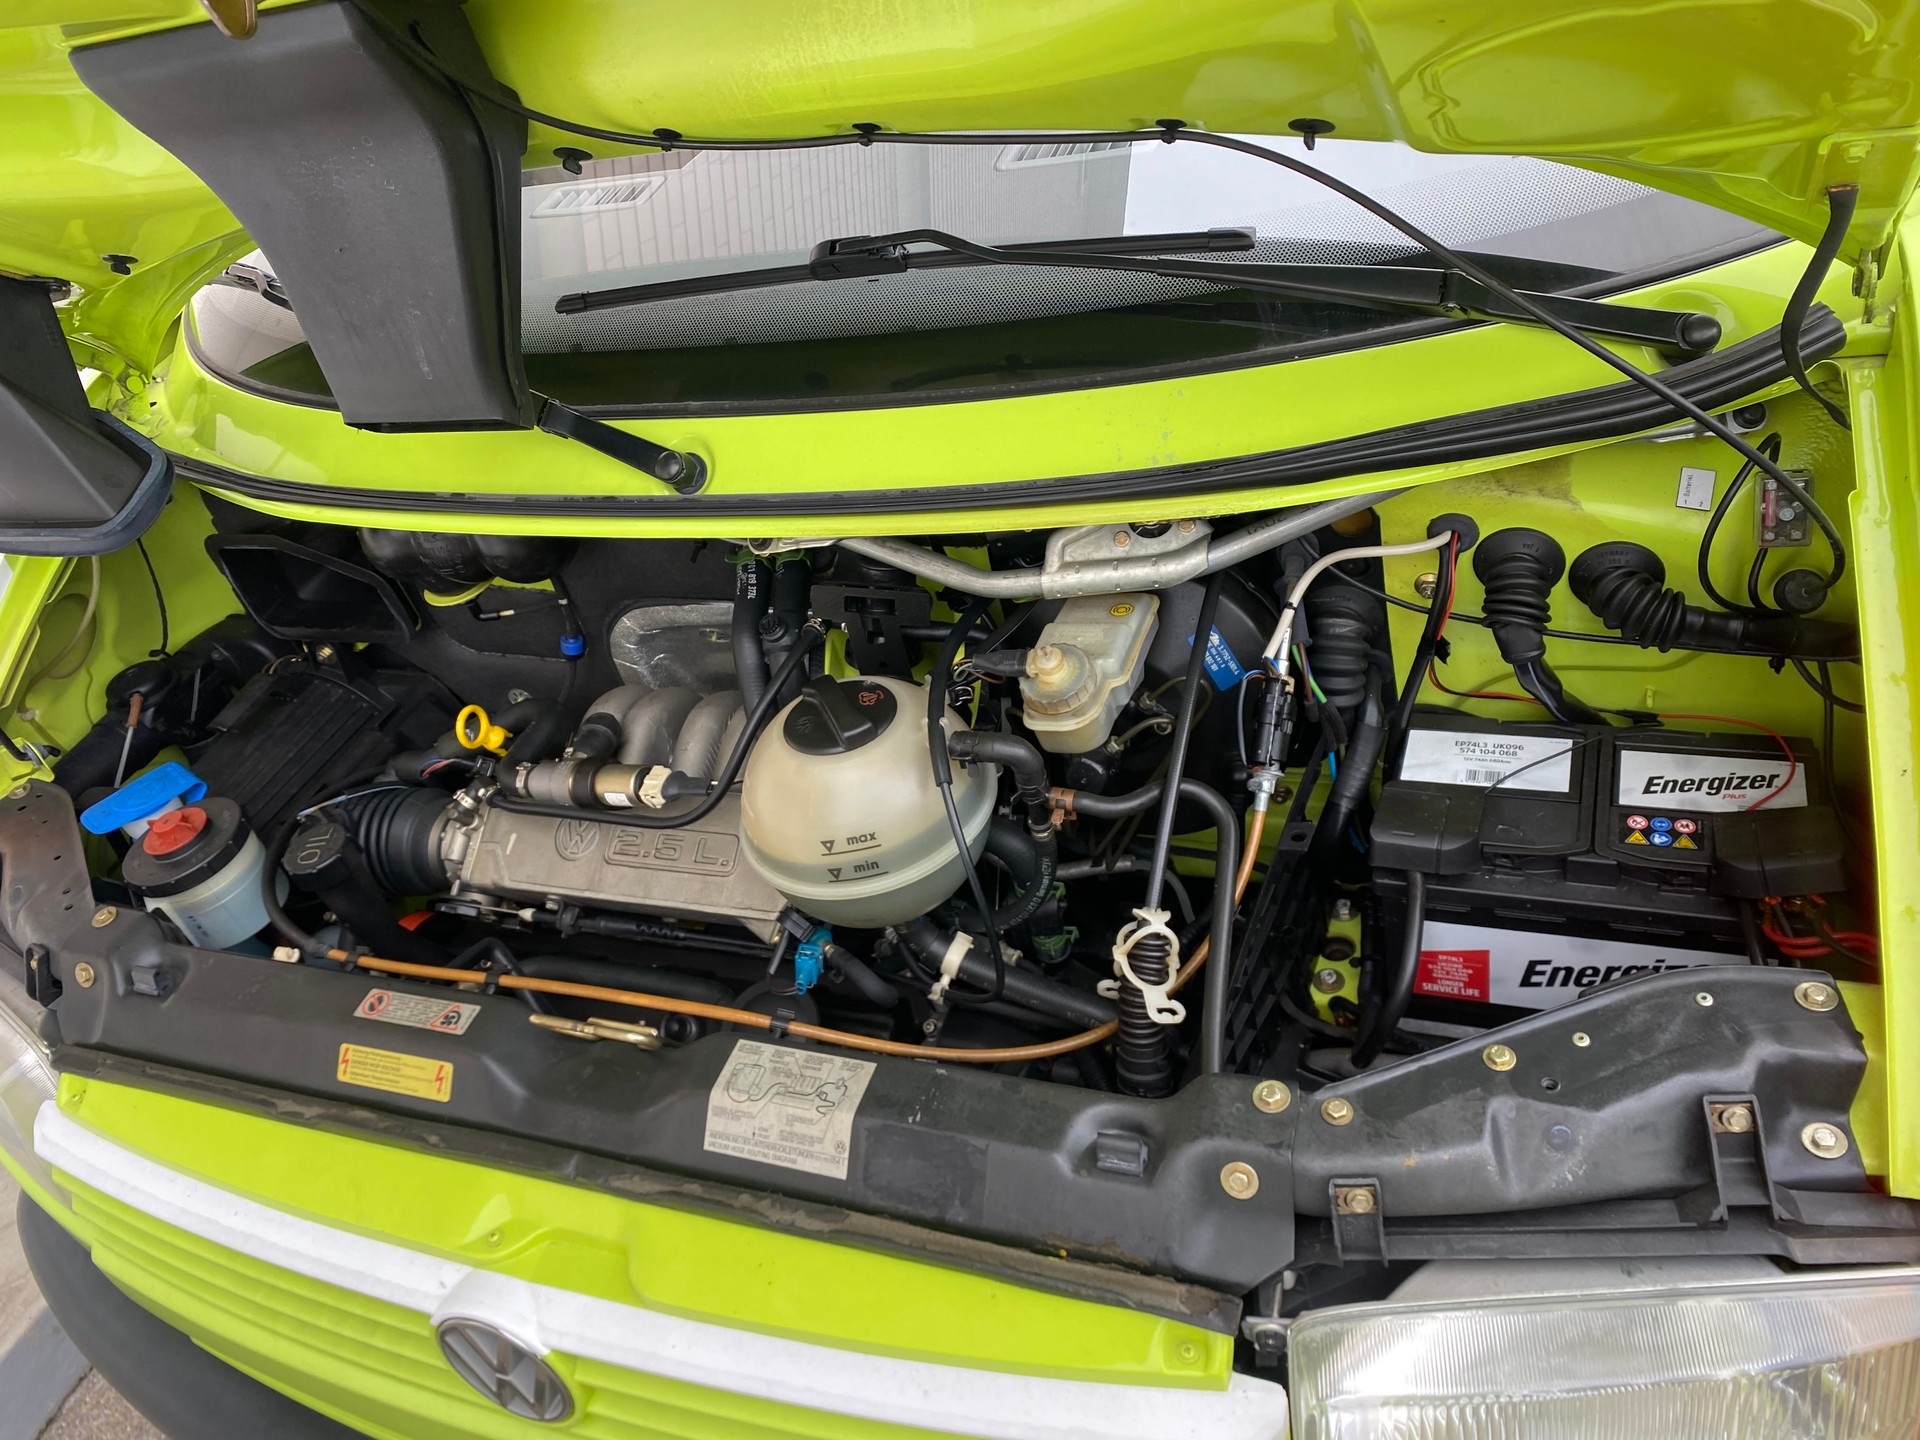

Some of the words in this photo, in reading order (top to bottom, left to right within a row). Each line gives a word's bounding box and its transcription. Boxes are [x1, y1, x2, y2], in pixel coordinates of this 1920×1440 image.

[1454, 740, 1488, 749] EP74L3
[1492, 742, 1525, 751] UK096
[1498, 749, 1518, 757] 068
[1641, 772, 1781, 796] Energizer
[297, 826, 335, 865] OIL
[612, 830, 686, 862] 2.5
[846, 831, 878, 846] max
[853, 860, 880, 873] min
[1422, 982, 1460, 995] SERVICE
[1460, 987, 1480, 997] LIFE
